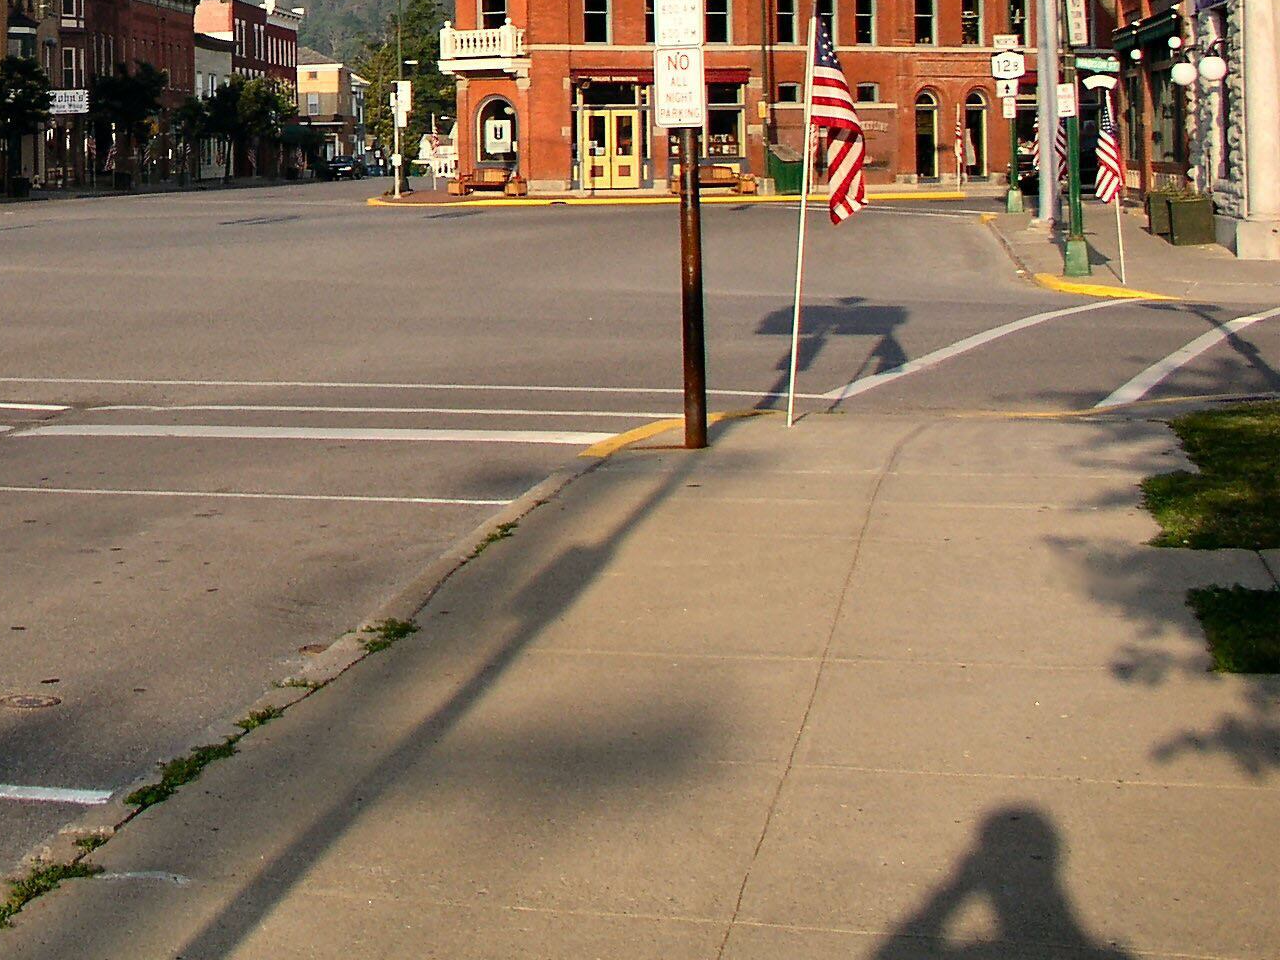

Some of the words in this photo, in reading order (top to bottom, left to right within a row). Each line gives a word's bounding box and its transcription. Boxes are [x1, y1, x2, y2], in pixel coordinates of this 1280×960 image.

[667, 54, 690, 71] NO
[671, 76, 688, 87] ALL
[665, 90, 693, 103] NIGHT
[660, 107, 701, 119] PARKING
